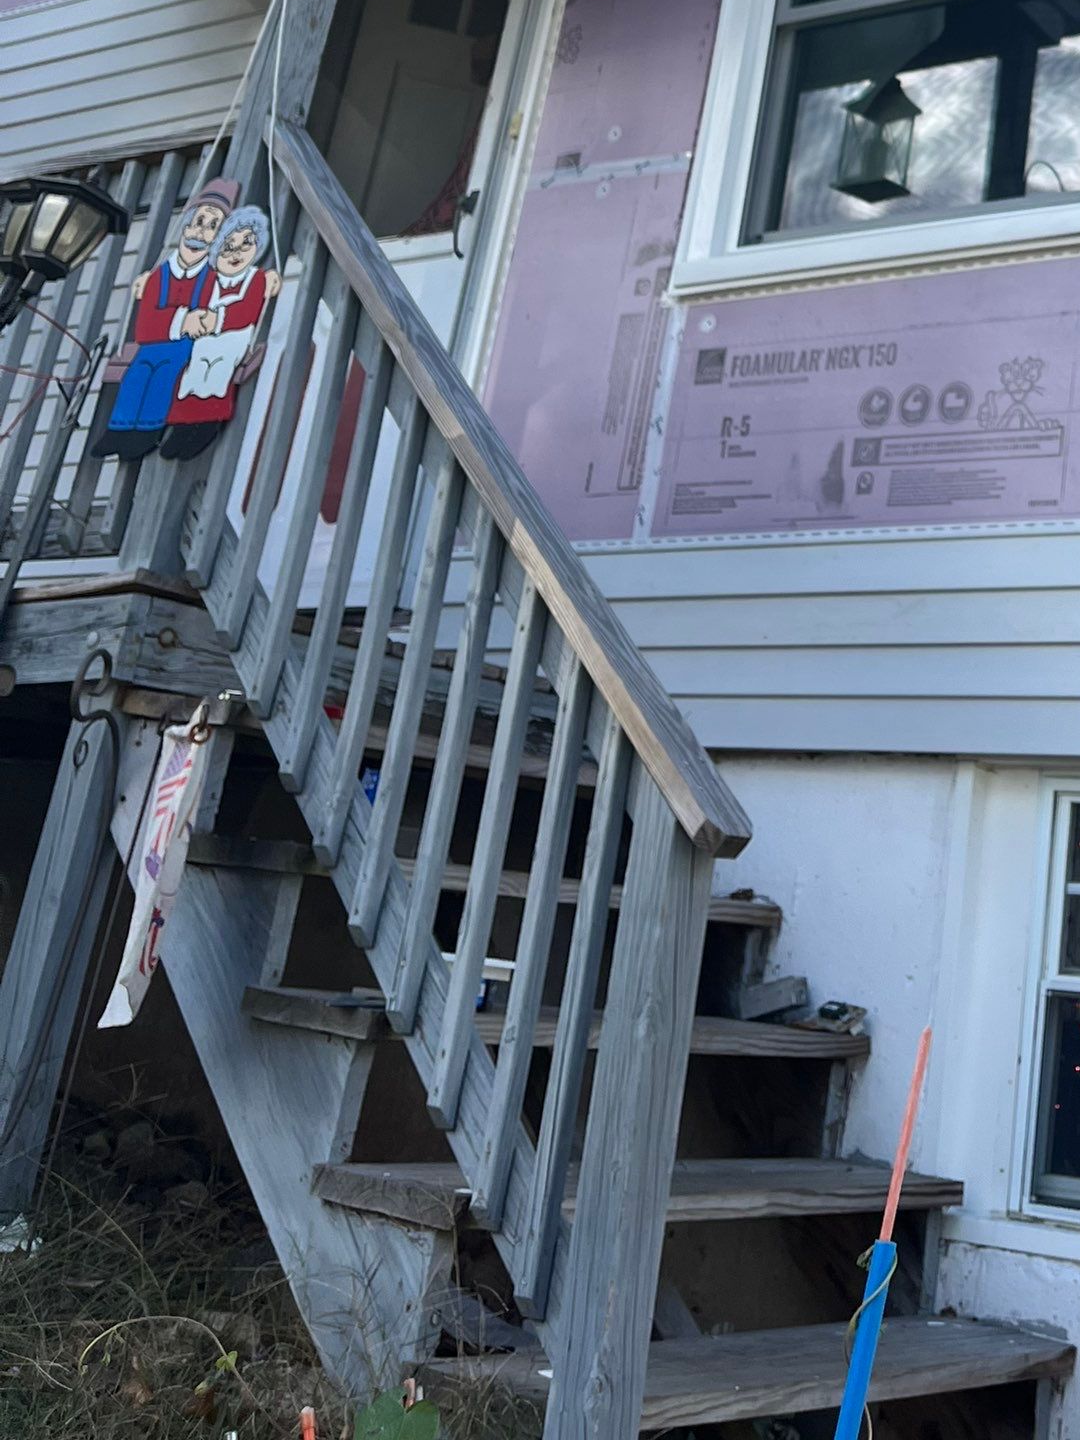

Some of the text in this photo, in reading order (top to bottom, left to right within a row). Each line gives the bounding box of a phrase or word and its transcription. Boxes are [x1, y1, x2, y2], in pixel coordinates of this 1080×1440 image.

[730, 348, 822, 378] FOAMULAR
[868, 342, 898, 368] 150
[720, 414, 752, 439] R-5
